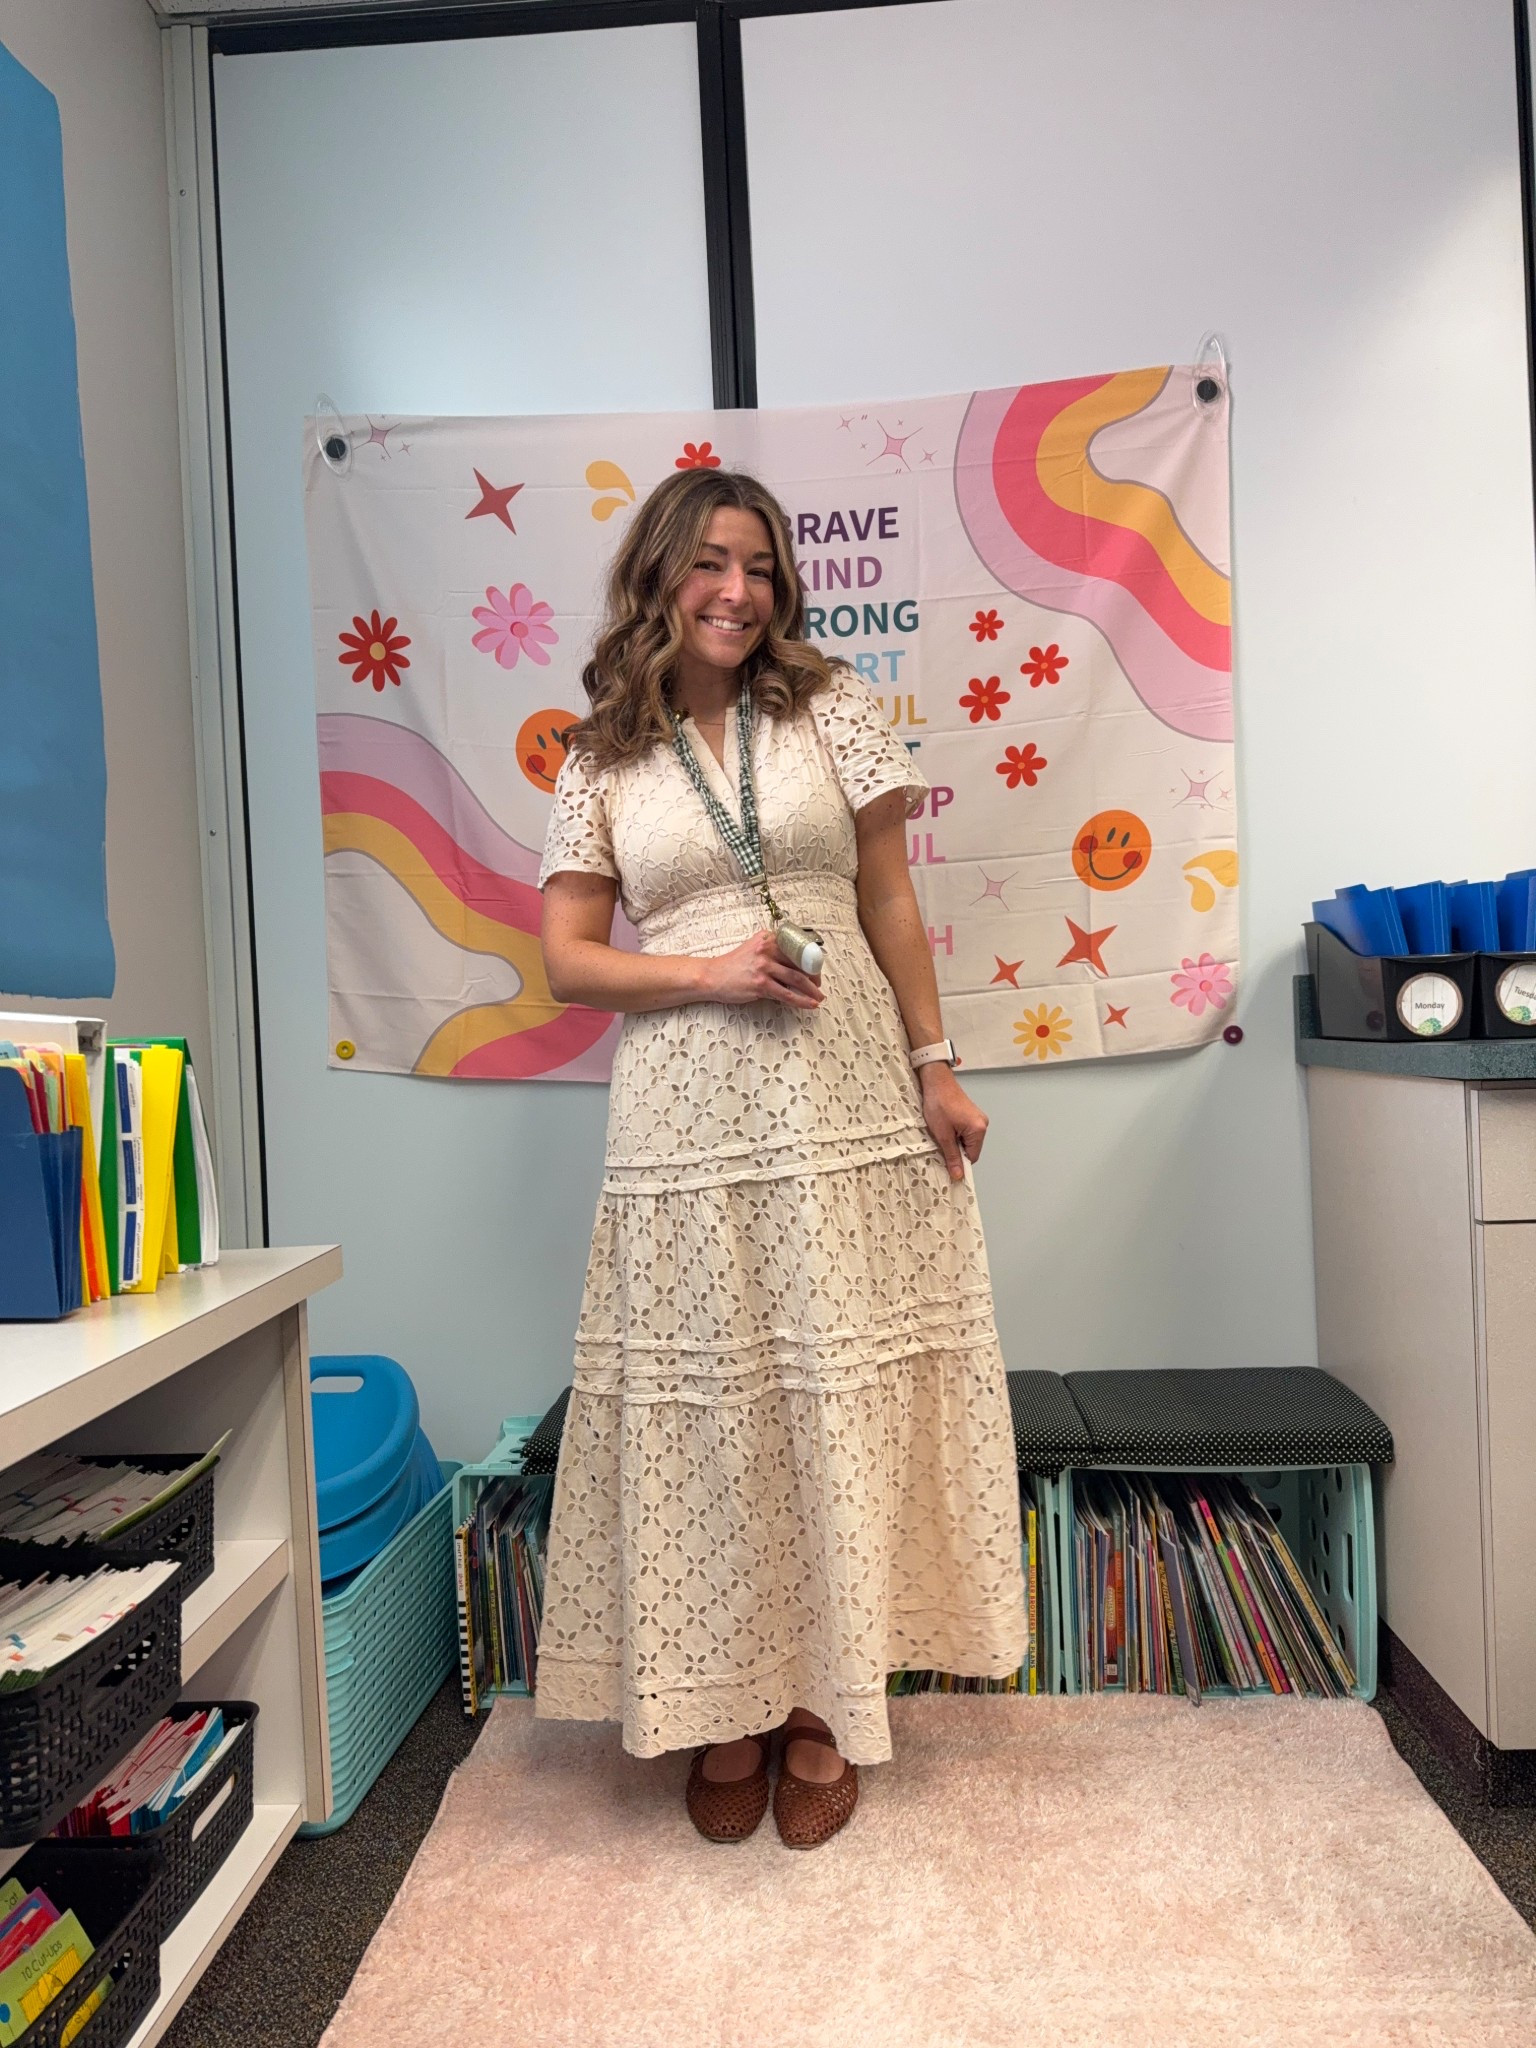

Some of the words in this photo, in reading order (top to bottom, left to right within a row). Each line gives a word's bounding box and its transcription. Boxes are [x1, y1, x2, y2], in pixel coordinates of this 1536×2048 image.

[804, 599, 919, 639] RONG
[1415, 1002, 1445, 1010] Monday
[1514, 986, 1536, 1000] Tuesda
[21, 1966, 33, 1981] 10
[31, 1940, 63, 1972] Cut-Ups
